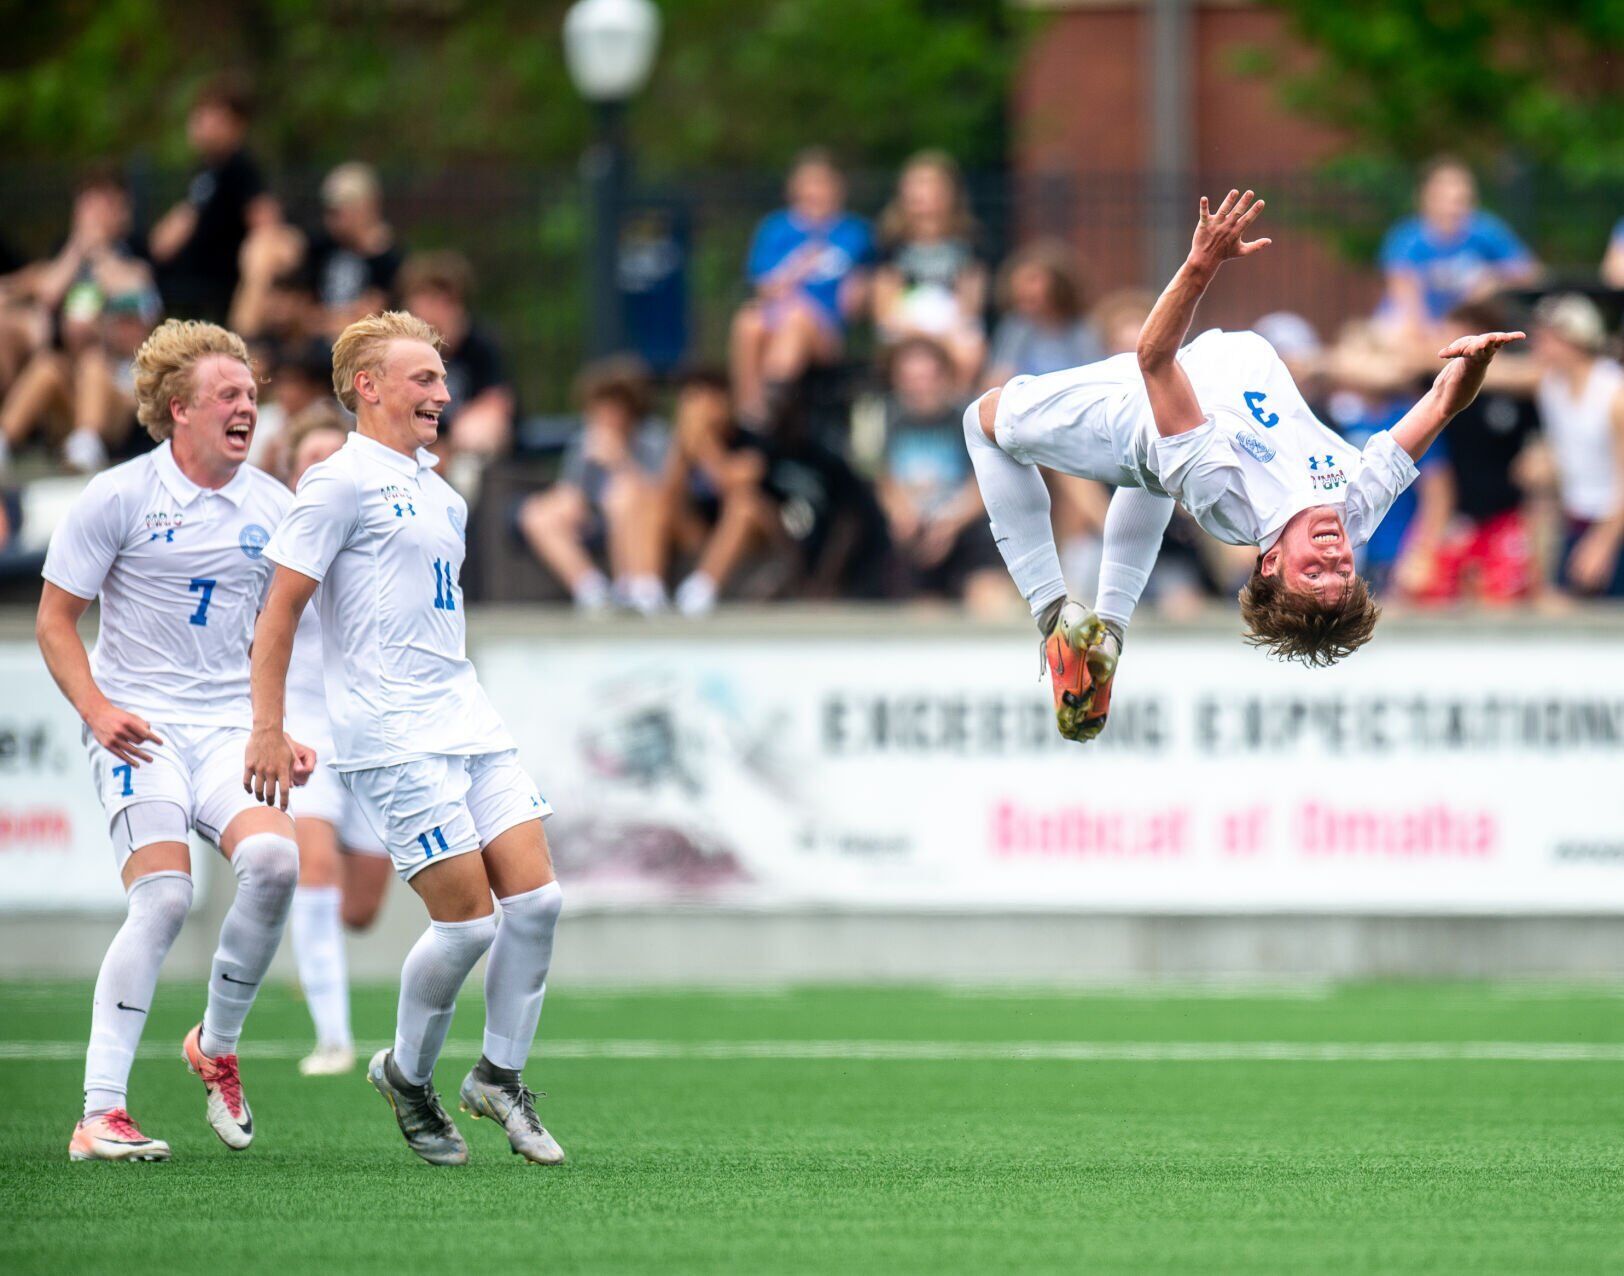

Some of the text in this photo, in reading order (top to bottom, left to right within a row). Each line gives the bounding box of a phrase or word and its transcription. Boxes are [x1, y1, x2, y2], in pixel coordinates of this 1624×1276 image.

[1242, 391, 1279, 428] 3
[189, 578, 216, 626] 7
[433, 557, 455, 610] 11
[822, 690, 1624, 752] EXCEEDNG EXPECTATION
[112, 763, 134, 798] 7
[417, 826, 449, 859] 11
